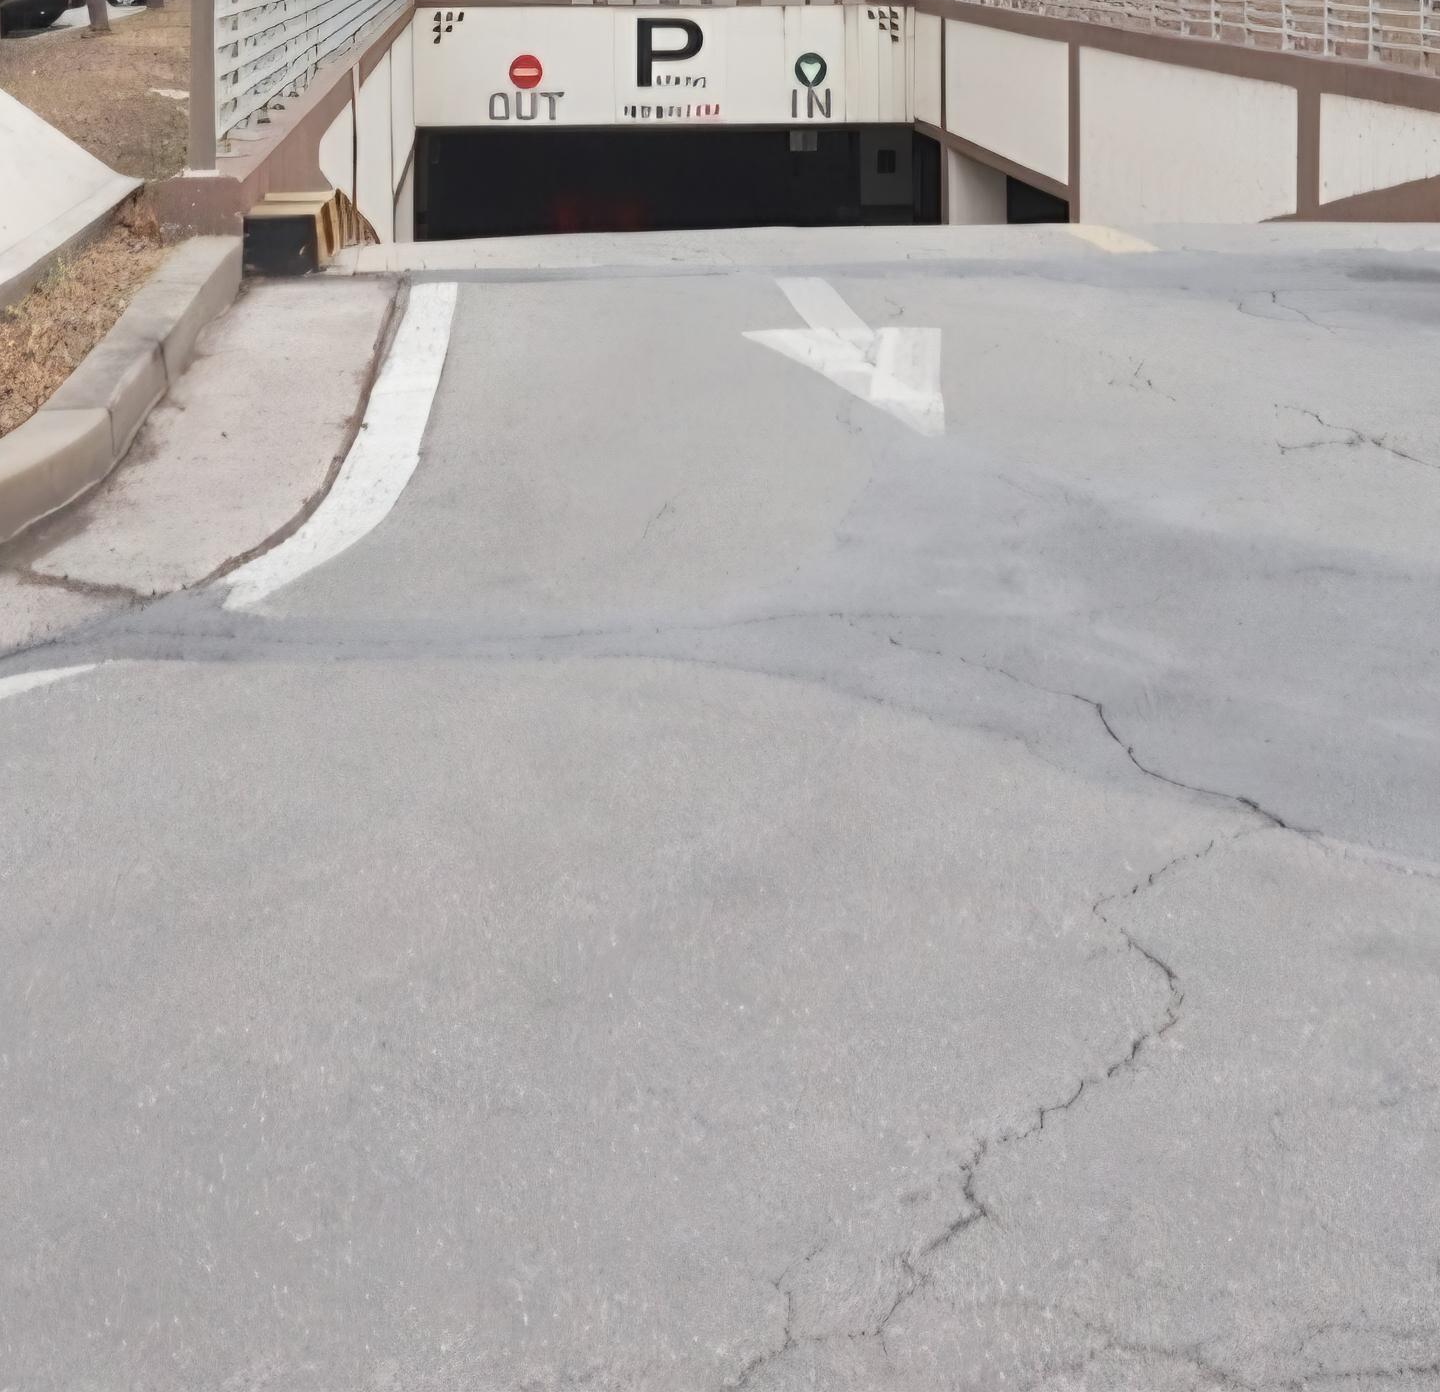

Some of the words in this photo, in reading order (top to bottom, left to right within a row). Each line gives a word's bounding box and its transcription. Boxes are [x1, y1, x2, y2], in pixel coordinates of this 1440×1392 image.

[636, 17, 704, 88] P
[488, 91, 565, 121] OUT
[791, 88, 832, 119] IN
